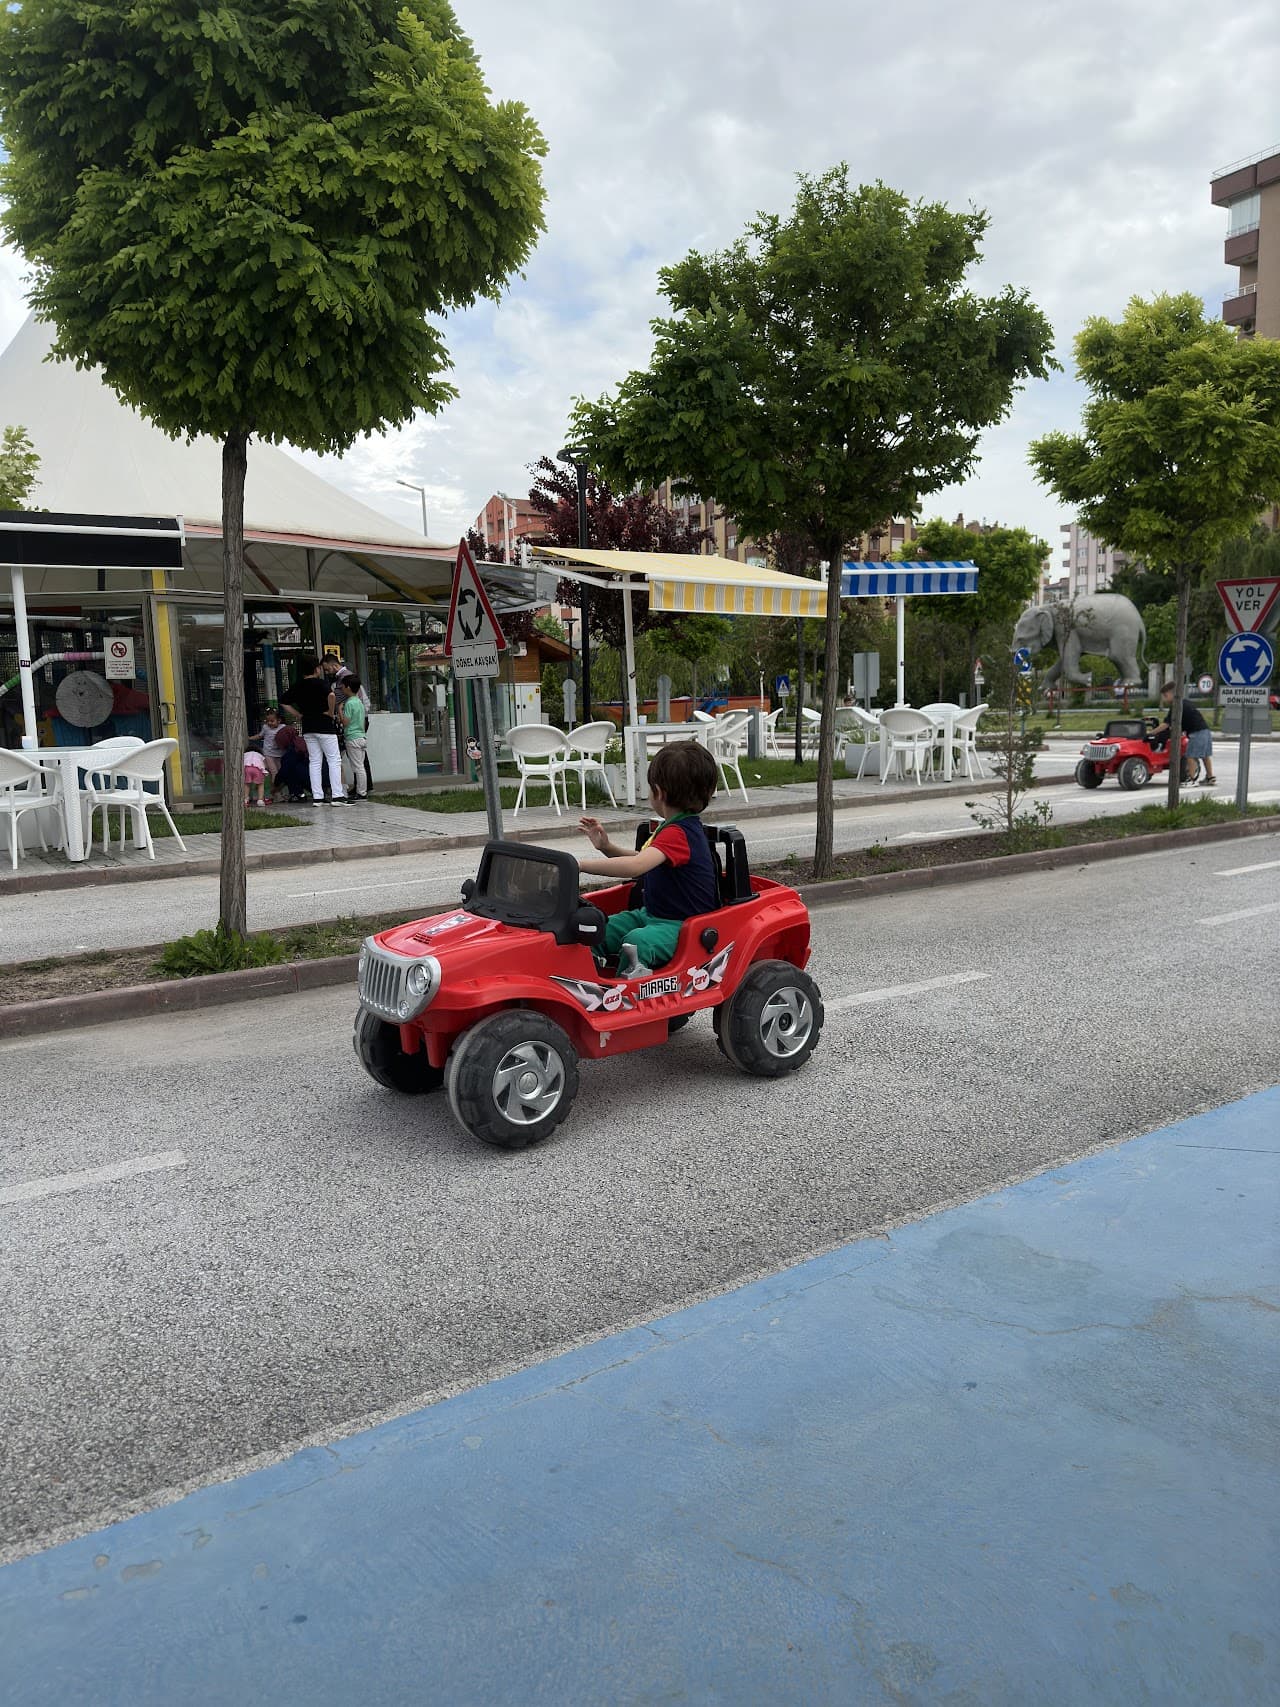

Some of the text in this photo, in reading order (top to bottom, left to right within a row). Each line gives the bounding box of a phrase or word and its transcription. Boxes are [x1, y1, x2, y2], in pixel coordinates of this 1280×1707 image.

[1236, 587, 1265, 598] YOL
[1236, 600, 1261, 611] VER
[1201, 680, 1211, 689] 70
[640, 976, 677, 999] MIRAGE
